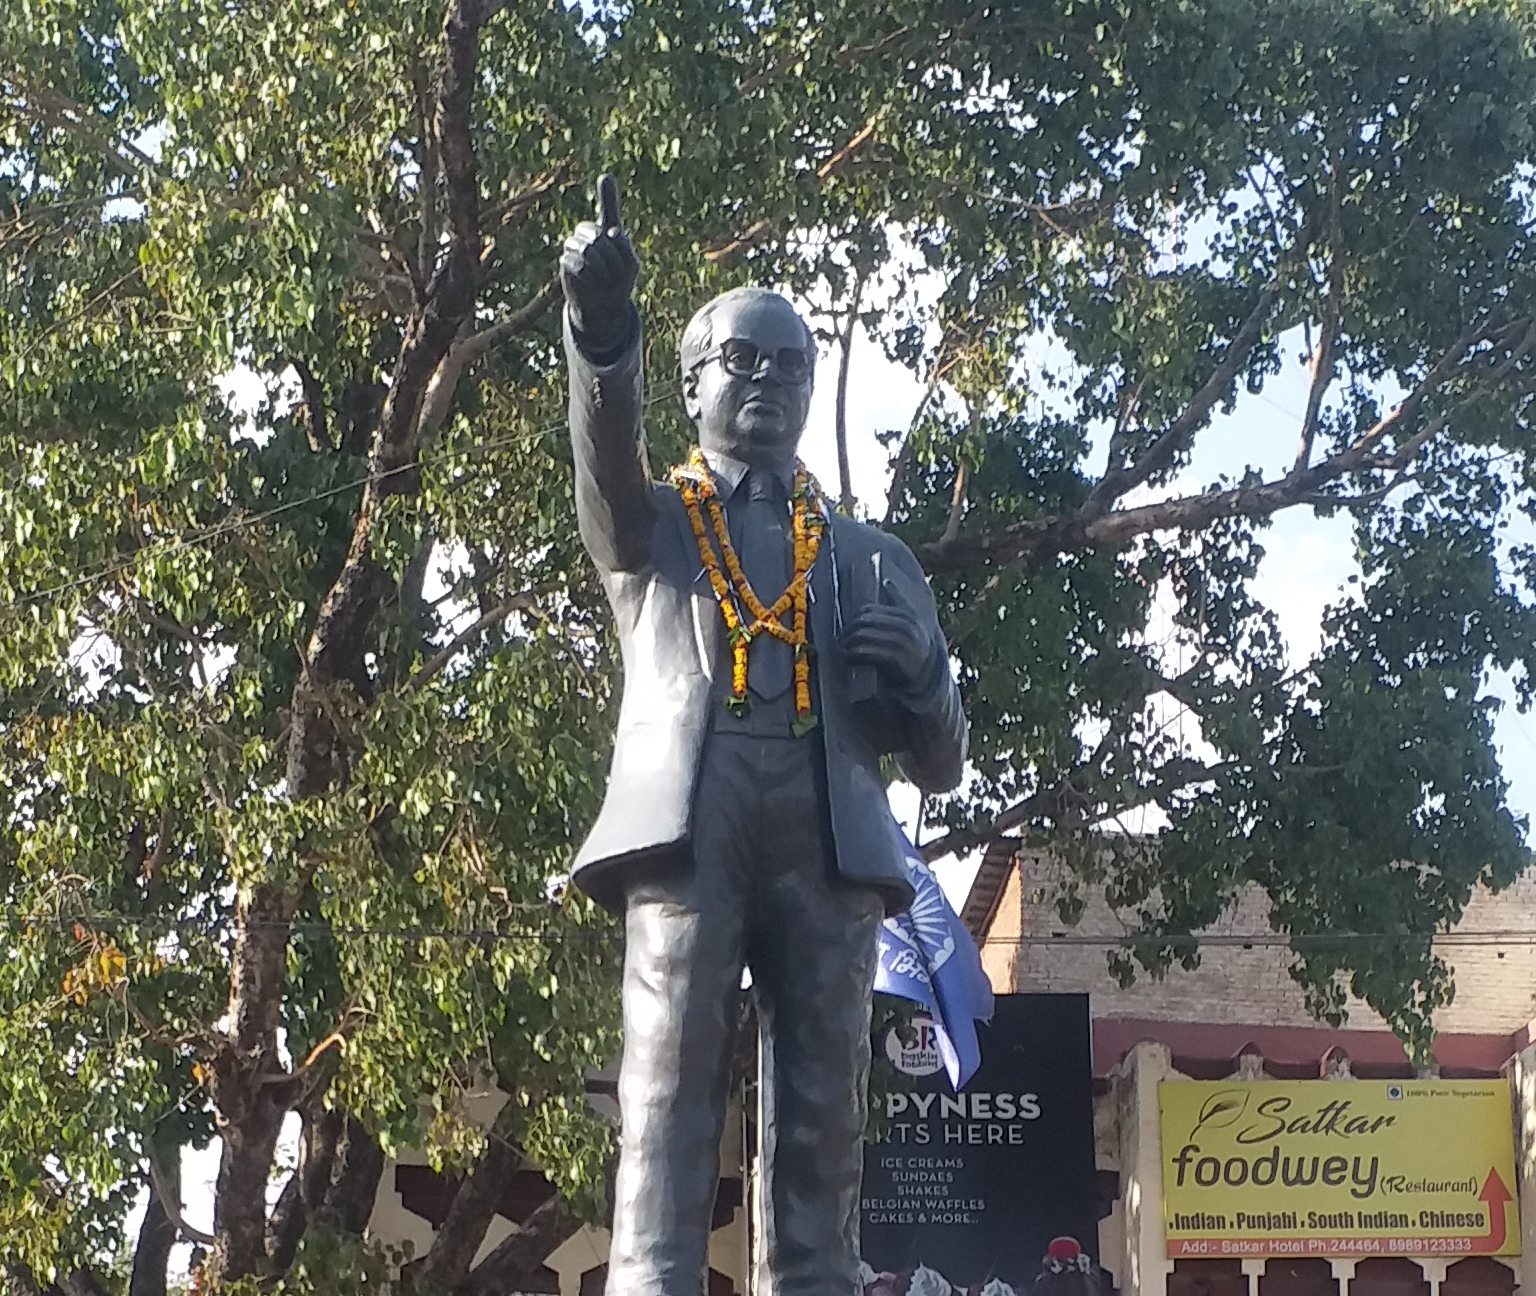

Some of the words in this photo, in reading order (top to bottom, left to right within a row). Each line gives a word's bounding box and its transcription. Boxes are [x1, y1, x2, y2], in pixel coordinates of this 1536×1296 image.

[874, 1091, 1042, 1120] PYNESS
[1235, 1096, 1396, 1145] Satkar
[944, 1123, 1024, 1145] HERE
[880, 1157, 903, 1168] ICE
[907, 1157, 964, 1169] CREAMS
[891, 1171, 954, 1182] SUNDAES
[1172, 1144, 1379, 1199] foodwey
[1380, 1175, 1479, 1197] (Restaurant)
[897, 1185, 949, 1196] SHAKES
[862, 1199, 921, 1210] BELGIAN
[925, 1199, 986, 1210] WAFFLES
[868, 1213, 914, 1224] CAKES
[917, 1213, 927, 1224] &
[1175, 1212, 1226, 1230] Indian
[1236, 1211, 1298, 1232] Punjabi
[1307, 1211, 1354, 1230] South
[1358, 1211, 1409, 1229] Indian
[1419, 1210, 1485, 1228] Chinese
[1221, 1240, 1266, 1253] Satkar
[1269, 1239, 1305, 1253] Hotel
